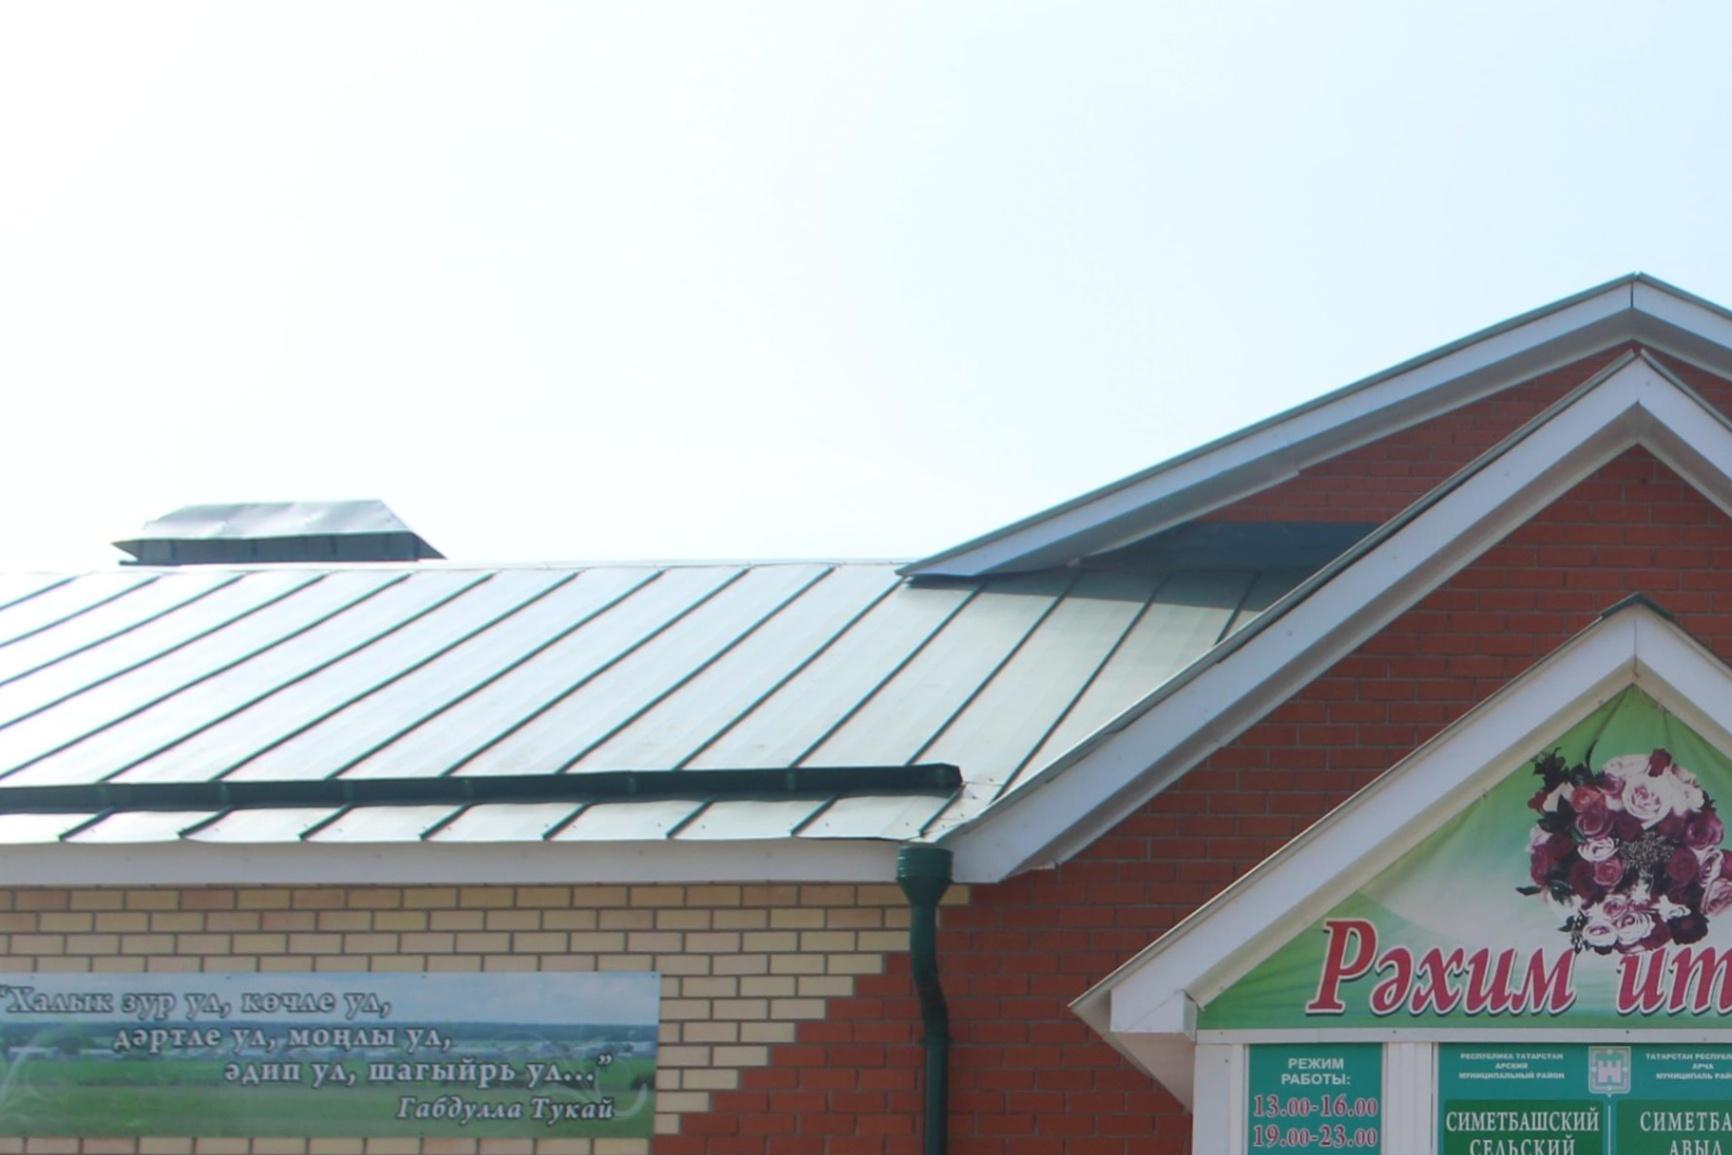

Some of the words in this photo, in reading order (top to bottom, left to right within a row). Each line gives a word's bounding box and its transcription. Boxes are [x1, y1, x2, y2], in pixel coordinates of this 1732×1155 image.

[1306, 917, 1578, 1017] Рәхим
[122, 993, 175, 1020] зур
[186, 993, 231, 1020] ул,
[242, 993, 335, 1013] көчле
[345, 993, 391, 1020] ул,
[114, 1028, 221, 1053] дәртле
[232, 1028, 276, 1053] ул,
[289, 1028, 395, 1052] моңлы
[406, 1028, 452, 1054] ул,
[224, 1062, 300, 1085] әдип
[312, 1063, 356, 1088] ул,
[368, 1057, 516, 1088] шагыйрь
[1287, 1057, 1345, 1070] РЕЖИМ
[1280, 1073, 1352, 1086] РАБОТЫ:
[397, 1097, 522, 1125] Габдулла
[531, 1098, 614, 1125] Тукай
[1253, 1093, 1378, 1118] 13.00-16.00
[1446, 1107, 1600, 1132] СИМЕТБАШСКИЙ
[1253, 1123, 1378, 1149] 19.00-23.00
